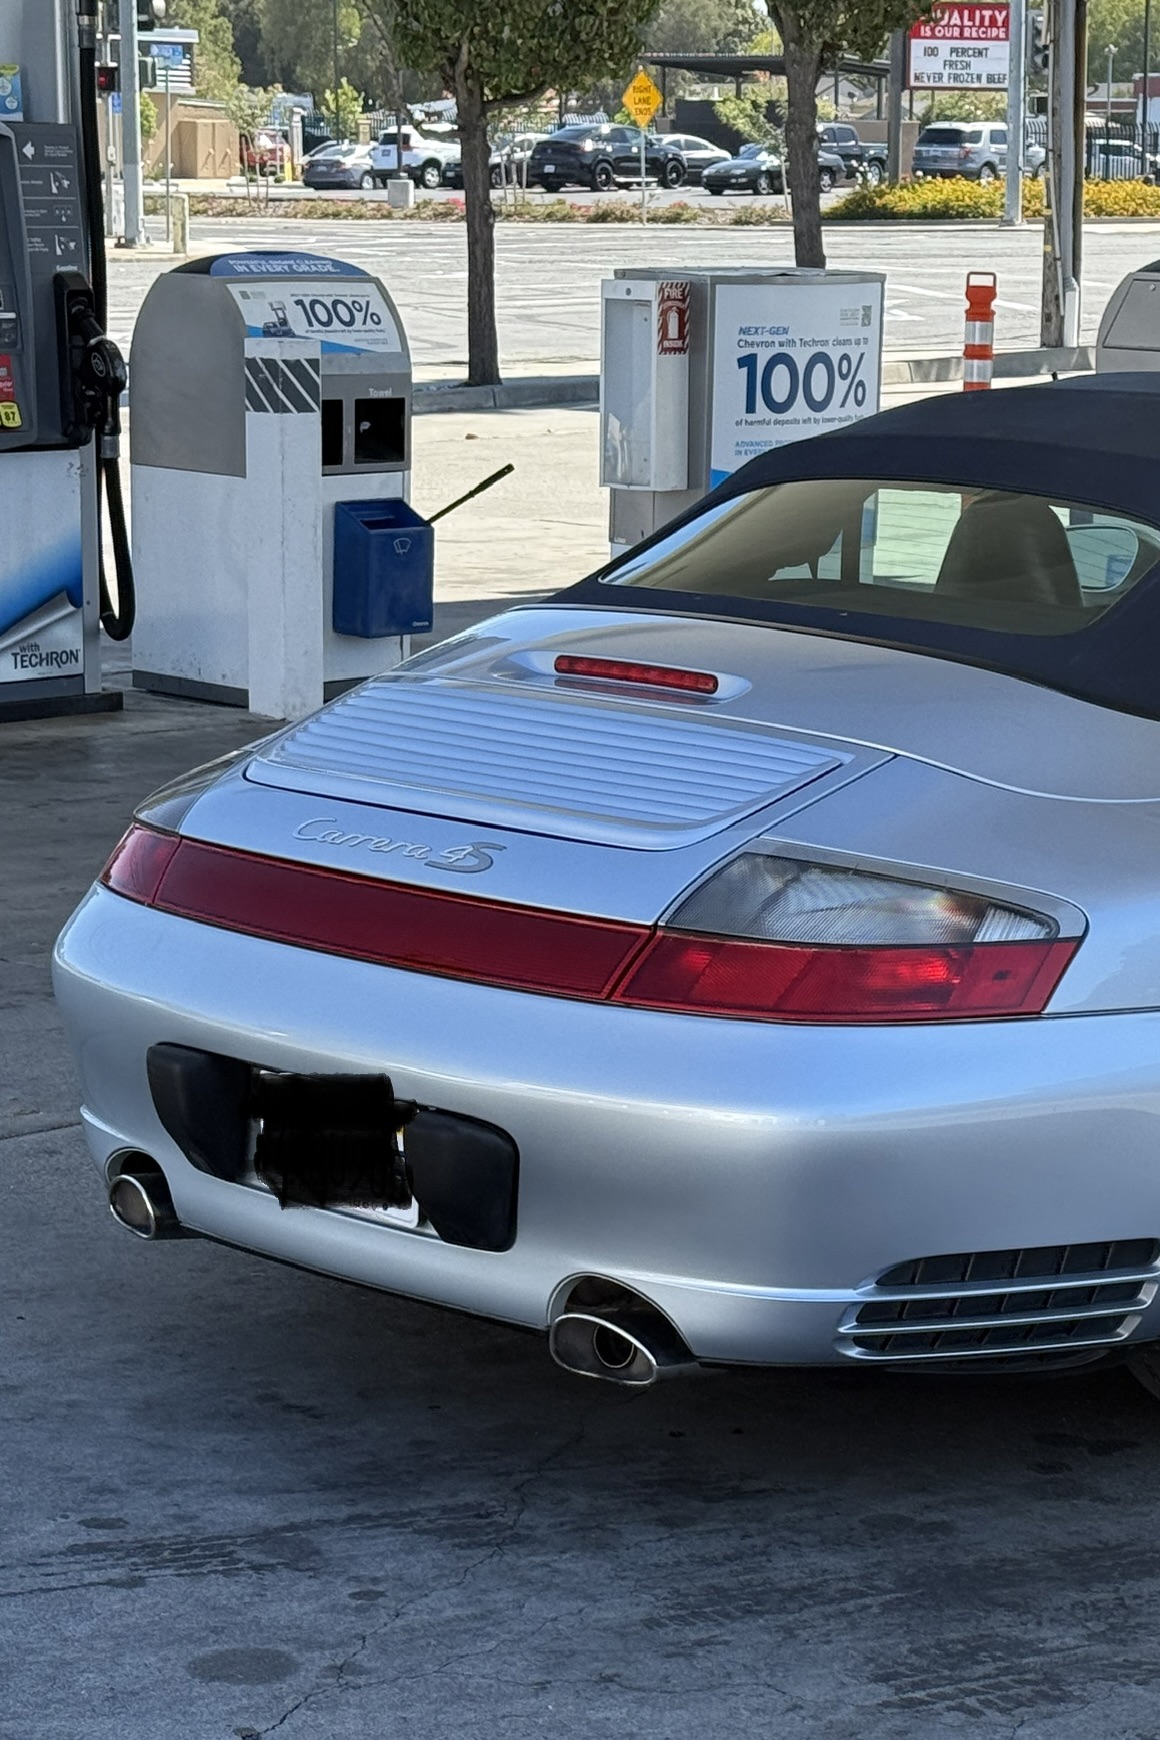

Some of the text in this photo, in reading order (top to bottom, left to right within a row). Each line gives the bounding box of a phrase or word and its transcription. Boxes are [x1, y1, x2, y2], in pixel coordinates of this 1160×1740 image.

[920, 9, 1008, 26] UALITY
[920, 26, 1006, 38] IS OUR RECIPE
[923, 46, 990, 59] 100 PERCENT
[943, 59, 971, 71] FRESH
[914, 72, 1008, 84] NEVER FROZEN BEEF
[632, 85, 652, 93] RIGHT
[633, 97, 652, 106] LANE
[634, 107, 652, 116] ENDS
[233, 264, 341, 273] IN EVERY GRADE.
[664, 288, 684, 299] FIRE
[293, 298, 382, 328] 100%
[738, 326, 790, 336] NEXT-GEN
[737, 338, 776, 349] Chevron
[778, 337, 797, 348] with
[831, 336, 853, 346] cleans
[854, 338, 862, 347] up
[862, 337, 869, 346] to
[736, 351, 867, 415] 100%
[368, 388, 393, 397] Towel
[4, 411, 16, 422] 87
[735, 417, 744, 427] of
[744, 417, 772, 427] harmful
[773, 417, 801, 428] deposits
[801, 415, 812, 426] left
[813, 416, 821, 426] by
[19, 642, 41, 653] with
[11, 649, 80, 670] TECHRON
[292, 817, 508, 874] Carrera 4S
